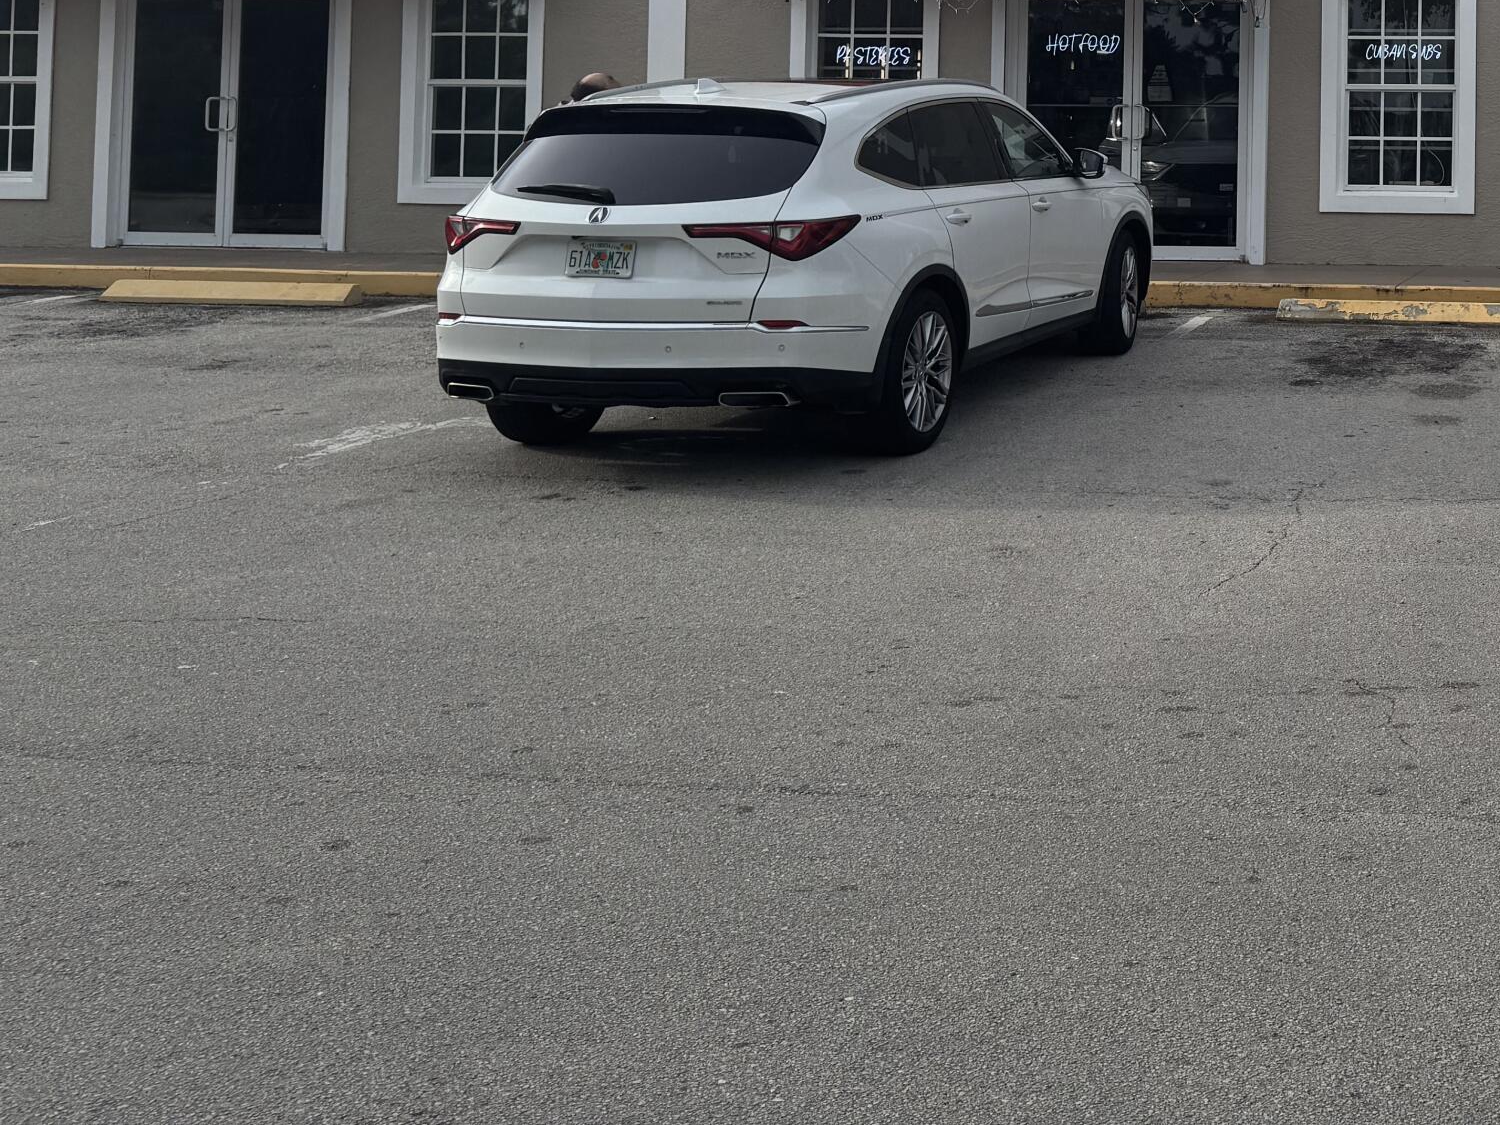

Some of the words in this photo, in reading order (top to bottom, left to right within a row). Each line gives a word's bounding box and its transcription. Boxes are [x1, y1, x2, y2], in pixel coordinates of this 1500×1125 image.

[1366, 44, 1406, 60] CUBAN
[1409, 44, 1441, 60] SUBS
[866, 215, 883, 223] MDX
[569, 251, 591, 268] 61A
[607, 251, 630, 269] MZK
[716, 251, 757, 260] MDX
